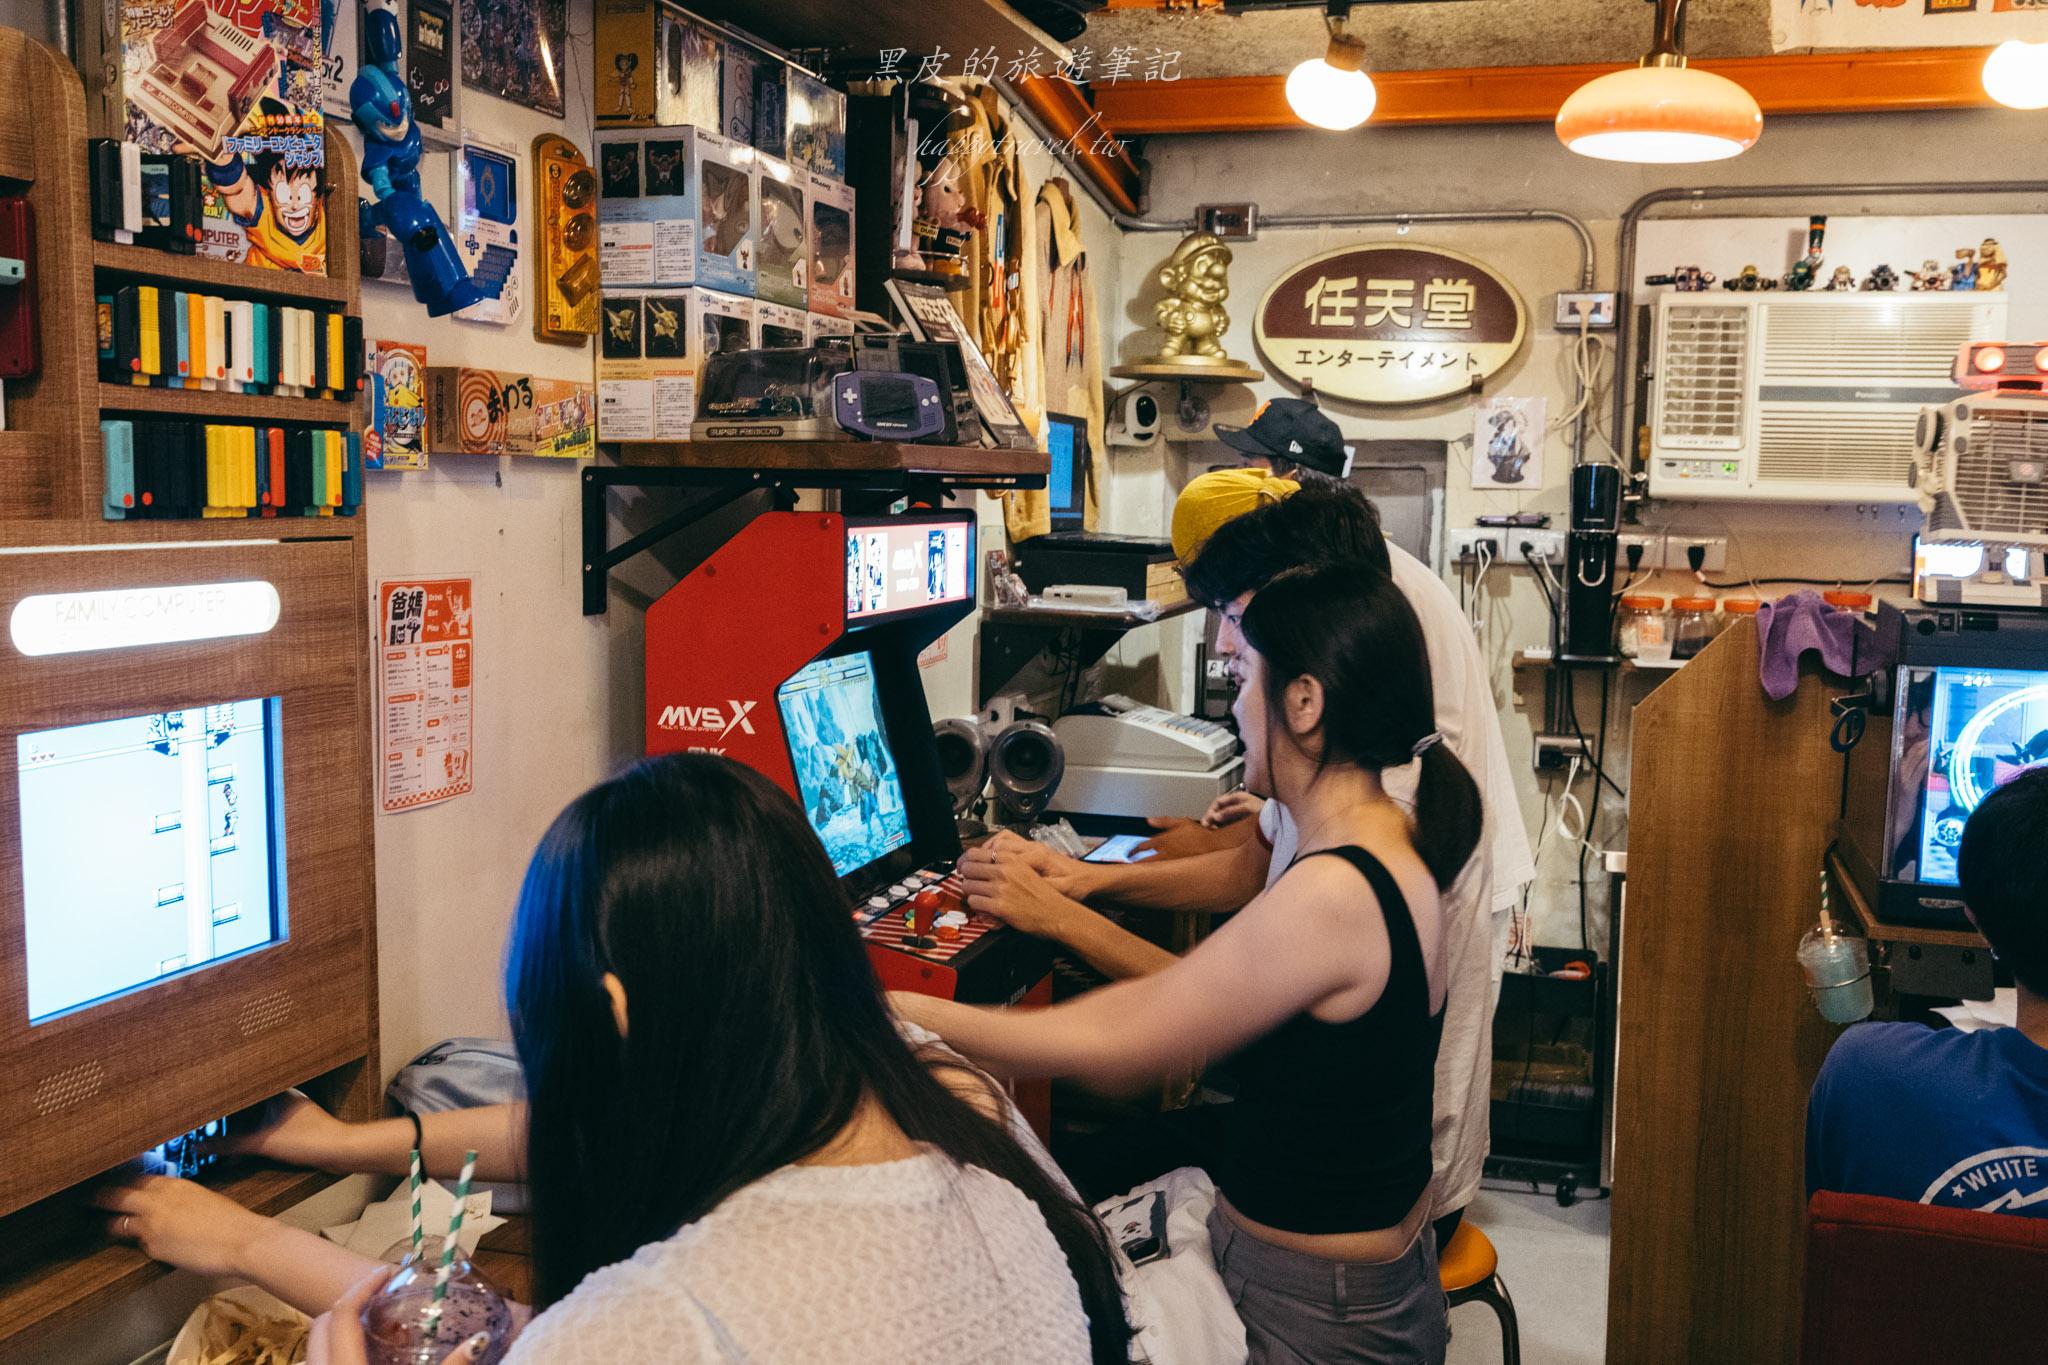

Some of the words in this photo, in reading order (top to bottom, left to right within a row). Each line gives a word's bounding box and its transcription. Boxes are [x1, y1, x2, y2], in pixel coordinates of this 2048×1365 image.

[1304, 276, 1476, 329] 任天堂
[487, 377, 533, 424] まわる
[1855, 391, 1891, 399] Panasonic
[1961, 1158, 2039, 1192] WHITE
